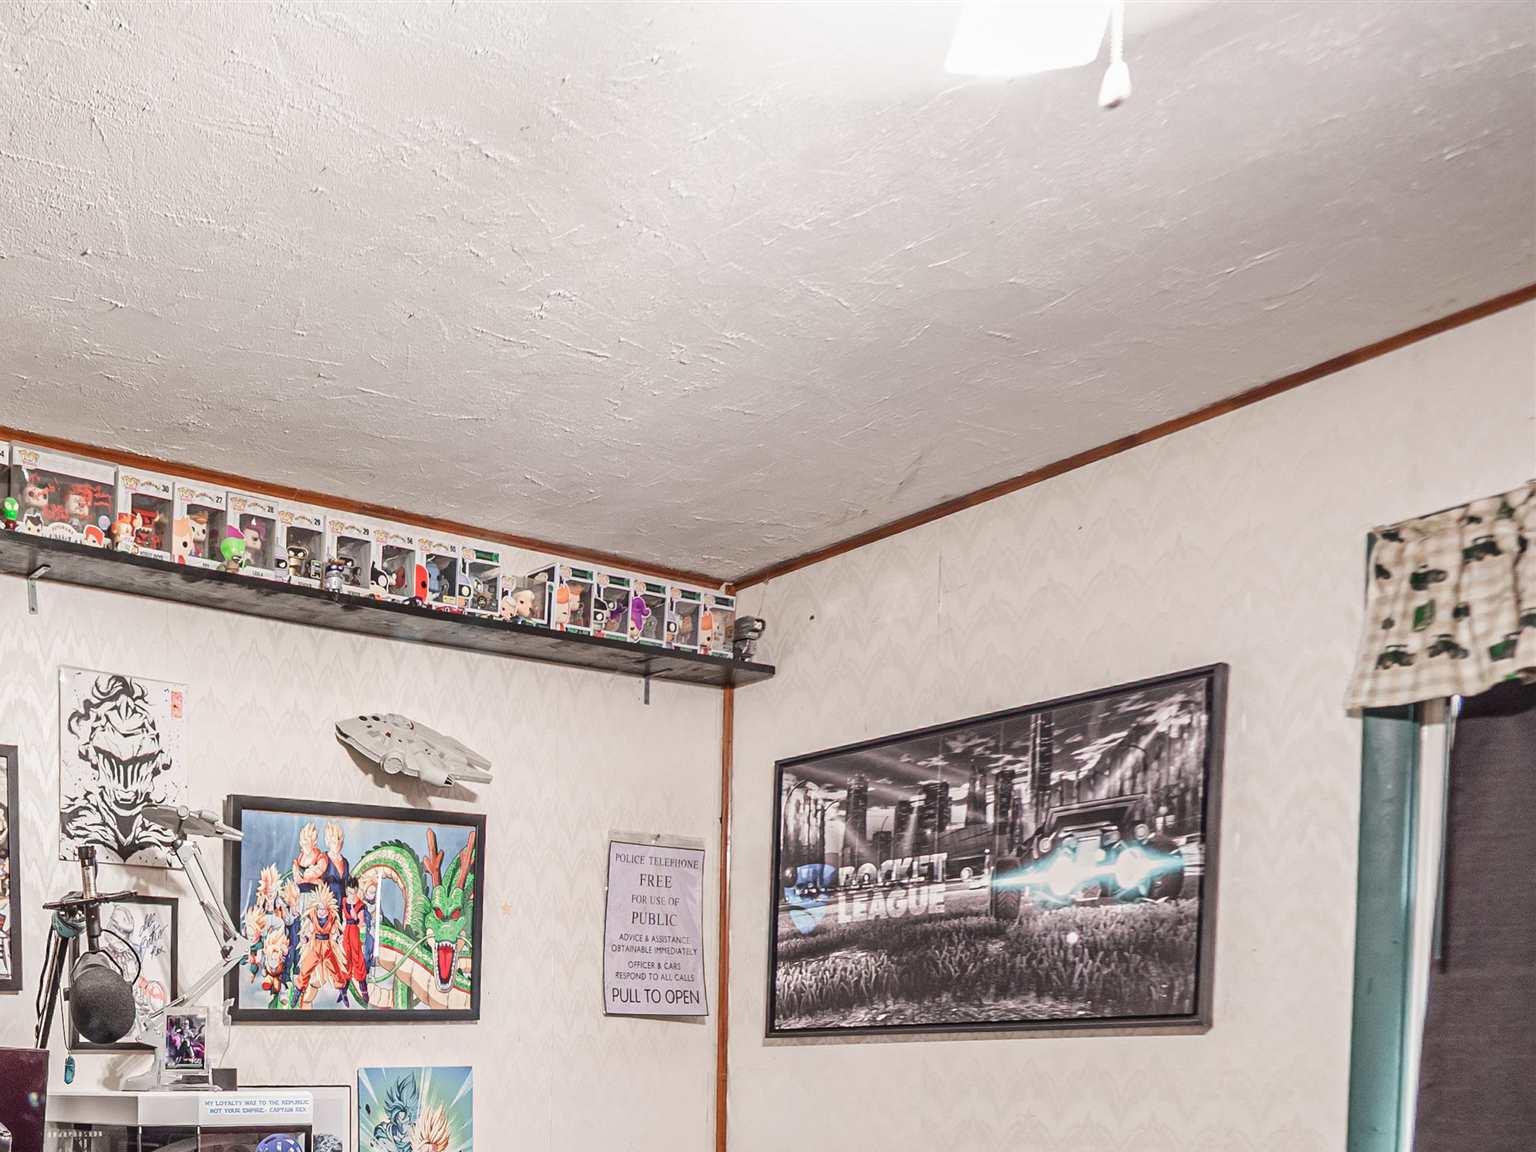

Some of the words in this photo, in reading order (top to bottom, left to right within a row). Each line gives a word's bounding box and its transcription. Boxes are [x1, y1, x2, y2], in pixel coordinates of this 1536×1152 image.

[215, 495, 223, 504] 27
[615, 853, 645, 865] POLICE
[649, 855, 699, 869] TELEPHONE
[838, 852, 948, 887] ROCKET
[639, 873, 673, 889] FREE
[631, 894, 648, 905] FOR
[650, 895, 665, 906] USE
[667, 896, 680, 907] OF
[838, 883, 946, 923] LEAGUE
[631, 911, 678, 927] PUBLIC
[619, 933, 642, 942] ADVICE
[651, 934, 691, 944] ASSISTANCE
[611, 944, 652, 954] OBTAINABLE
[654, 946, 697, 956] IMMEDIATELY
[627, 961, 655, 970] OFFICER
[664, 962, 681, 970] CARS
[615, 971, 646, 981] RESPOND
[648, 972, 658, 980] TO
[661, 972, 672, 981] ALL
[674, 973, 695, 982] CALLS
[612, 987, 641, 1003] PULL
[644, 988, 661, 1004] TO
[665, 989, 700, 1005] OPEN
